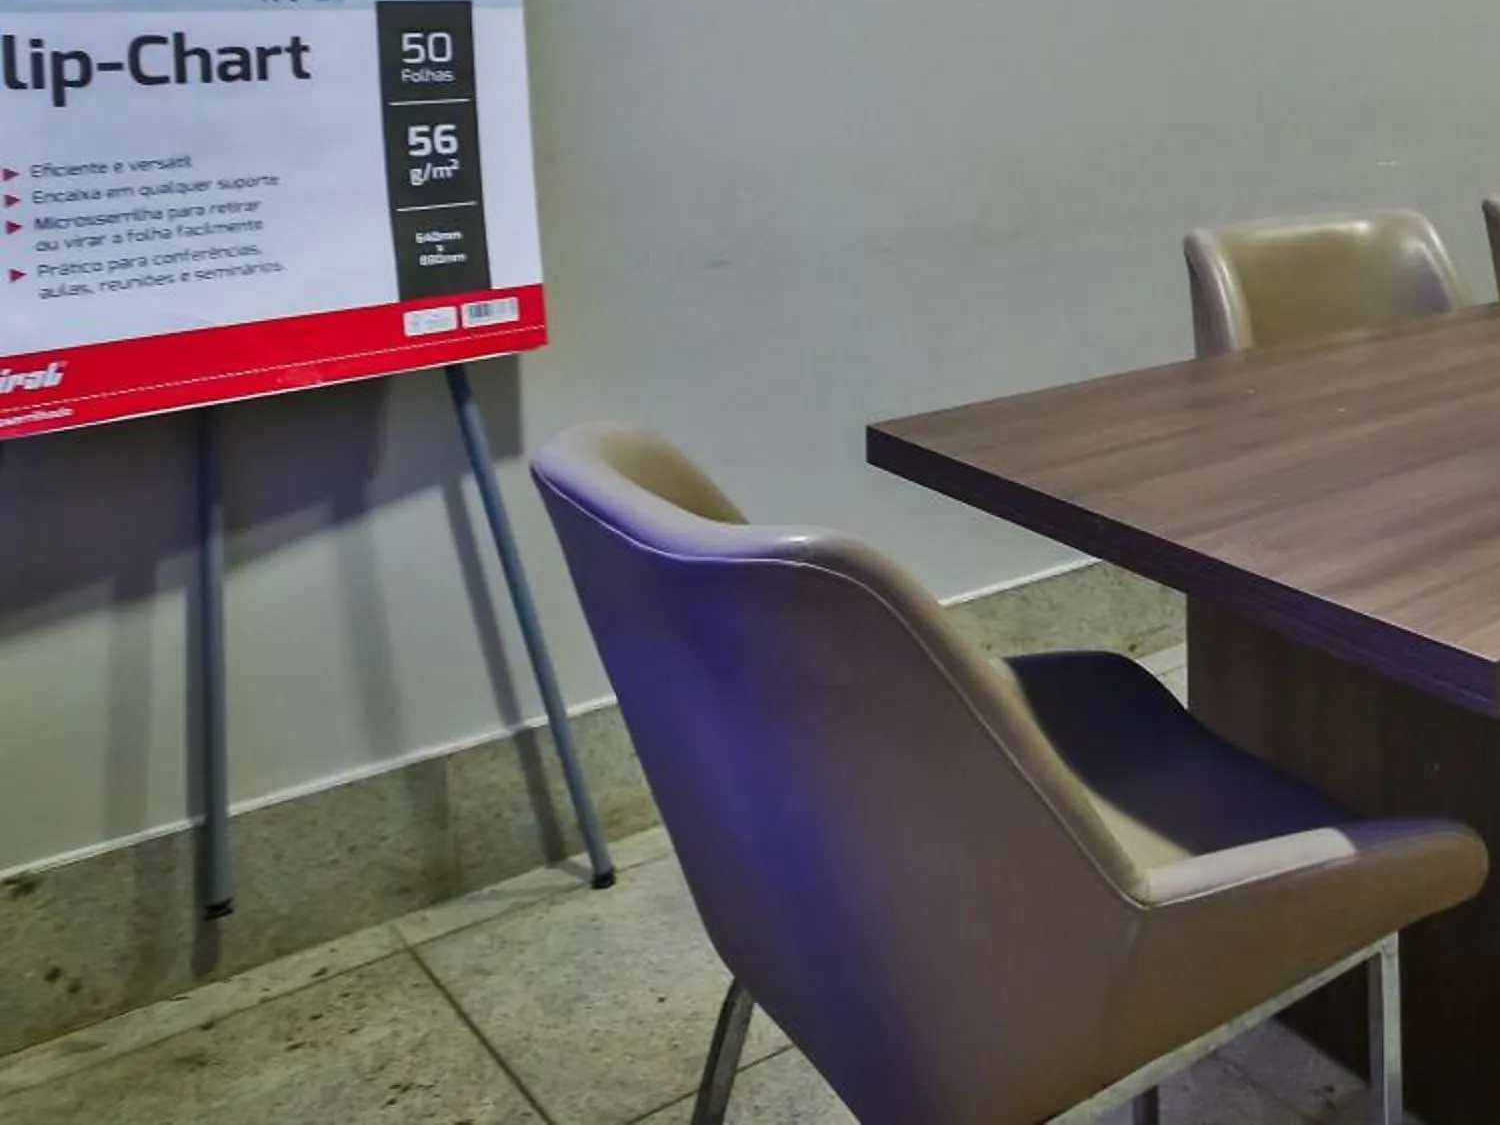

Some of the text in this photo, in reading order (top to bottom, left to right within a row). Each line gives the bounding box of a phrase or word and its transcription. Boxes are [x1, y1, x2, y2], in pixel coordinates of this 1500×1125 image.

[402, 32, 453, 64] 50
[401, 68, 456, 83] Folhas
[408, 125, 458, 156] 56
